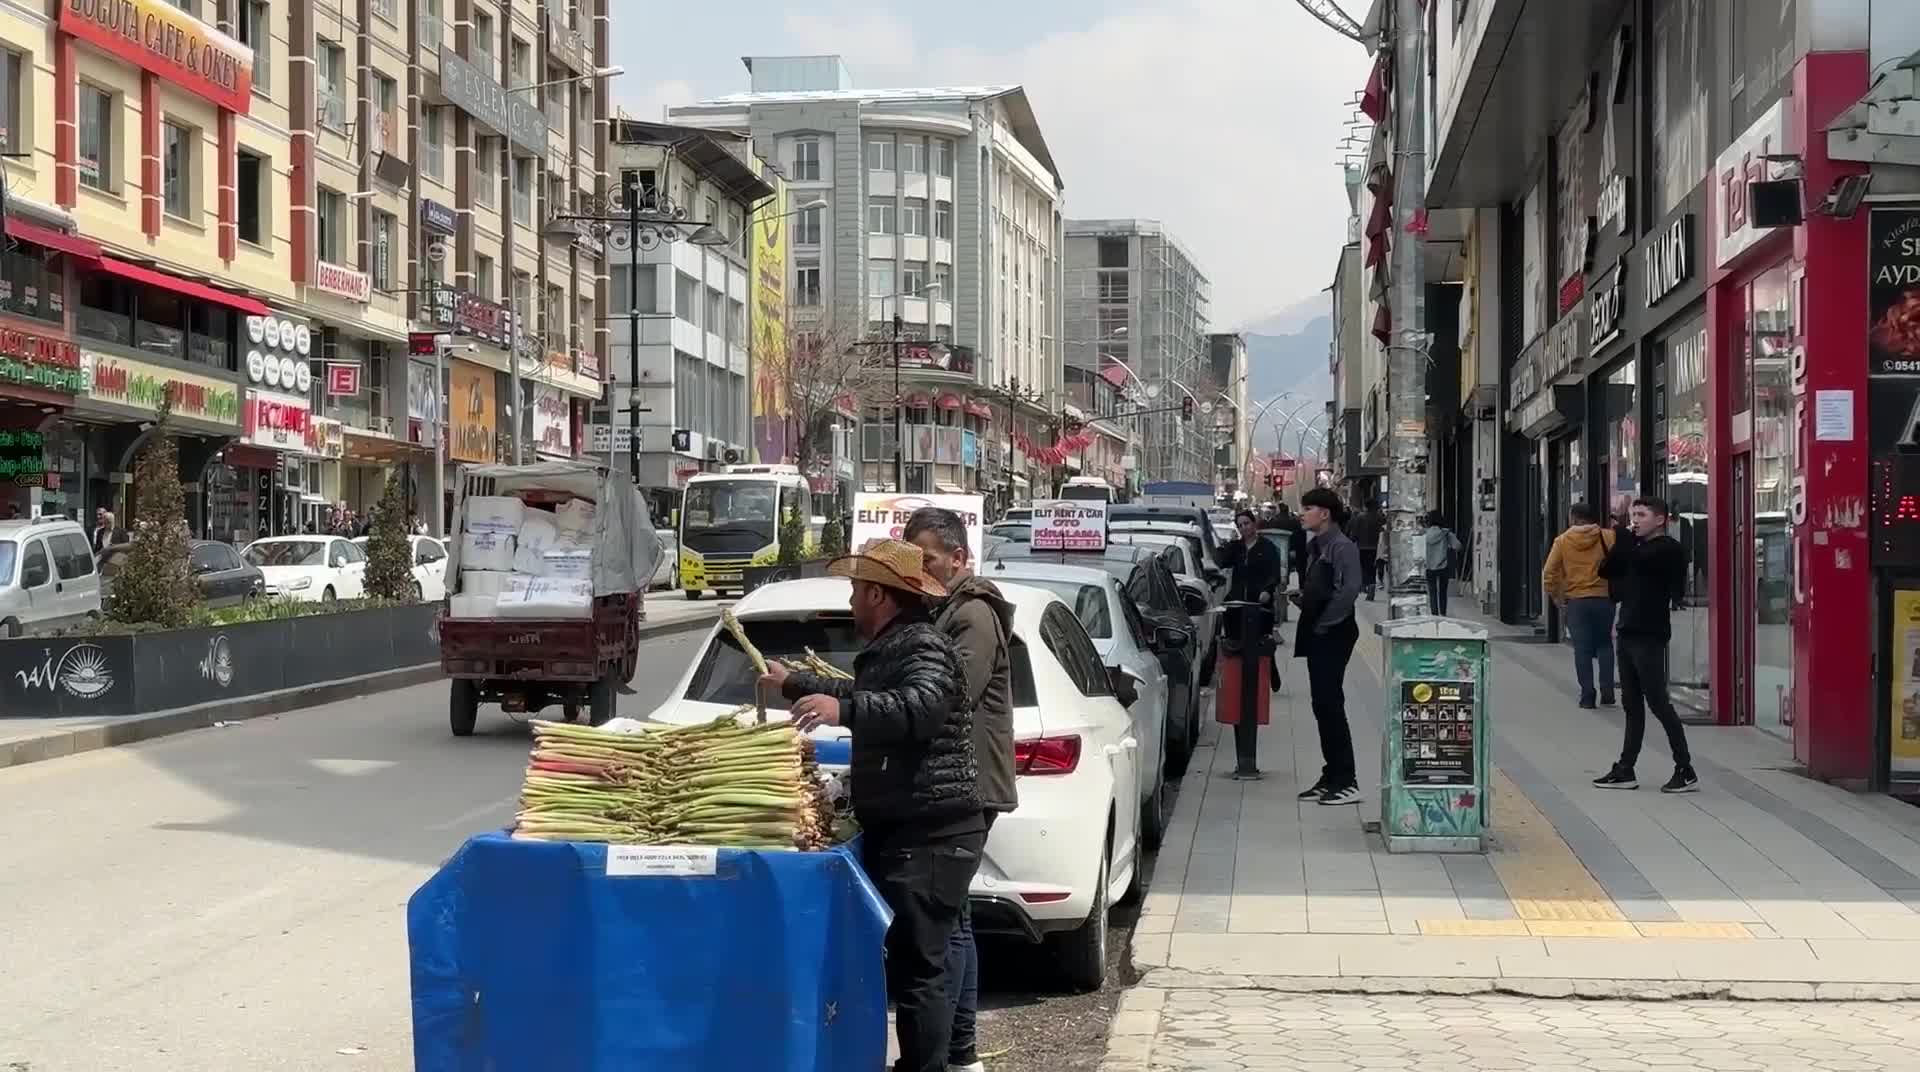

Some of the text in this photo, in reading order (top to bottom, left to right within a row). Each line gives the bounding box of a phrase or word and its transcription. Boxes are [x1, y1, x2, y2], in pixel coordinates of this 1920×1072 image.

[145, 12, 184, 65] CAFE
[186, 36, 198, 71] &
[202, 44, 242, 93] OKEY
[320, 265, 363, 297] BERBERHANE
[336, 369, 352, 391] E
[858, 507, 889, 524] ELİT
[1052, 518, 1081, 527] OTO
[1054, 507, 1077, 518] RENT
[1086, 509, 1103, 519] CAR
